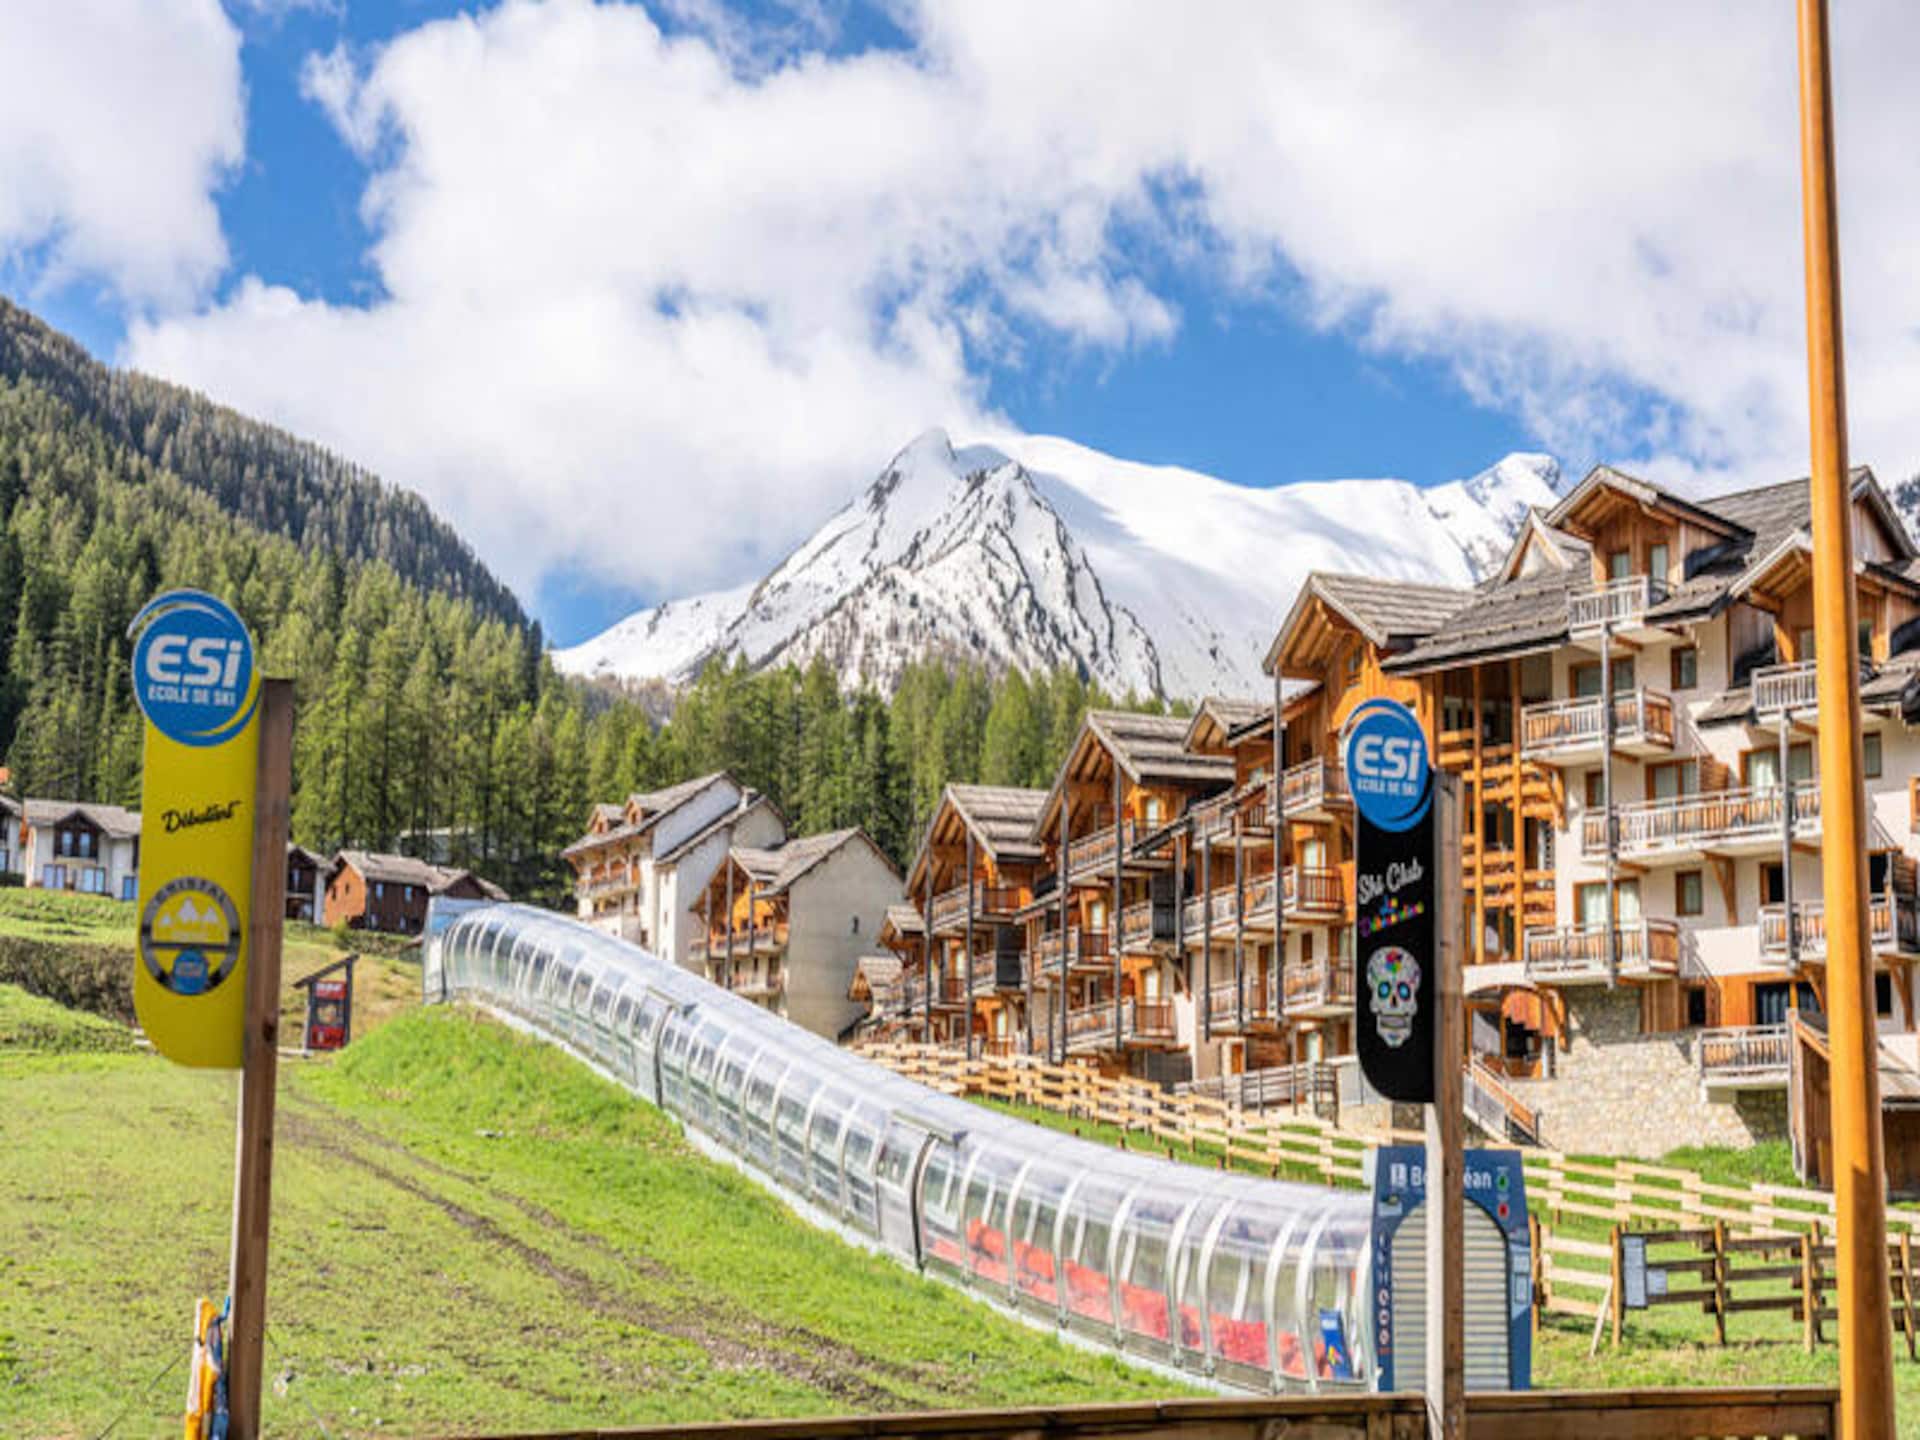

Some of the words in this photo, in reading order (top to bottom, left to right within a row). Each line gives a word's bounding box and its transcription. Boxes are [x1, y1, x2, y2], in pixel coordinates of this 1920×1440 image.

[192, 687, 210, 705] DE
[213, 690, 236, 706] SKI
[1359, 873, 1385, 905] Ski
[1386, 856, 1424, 893] Club
